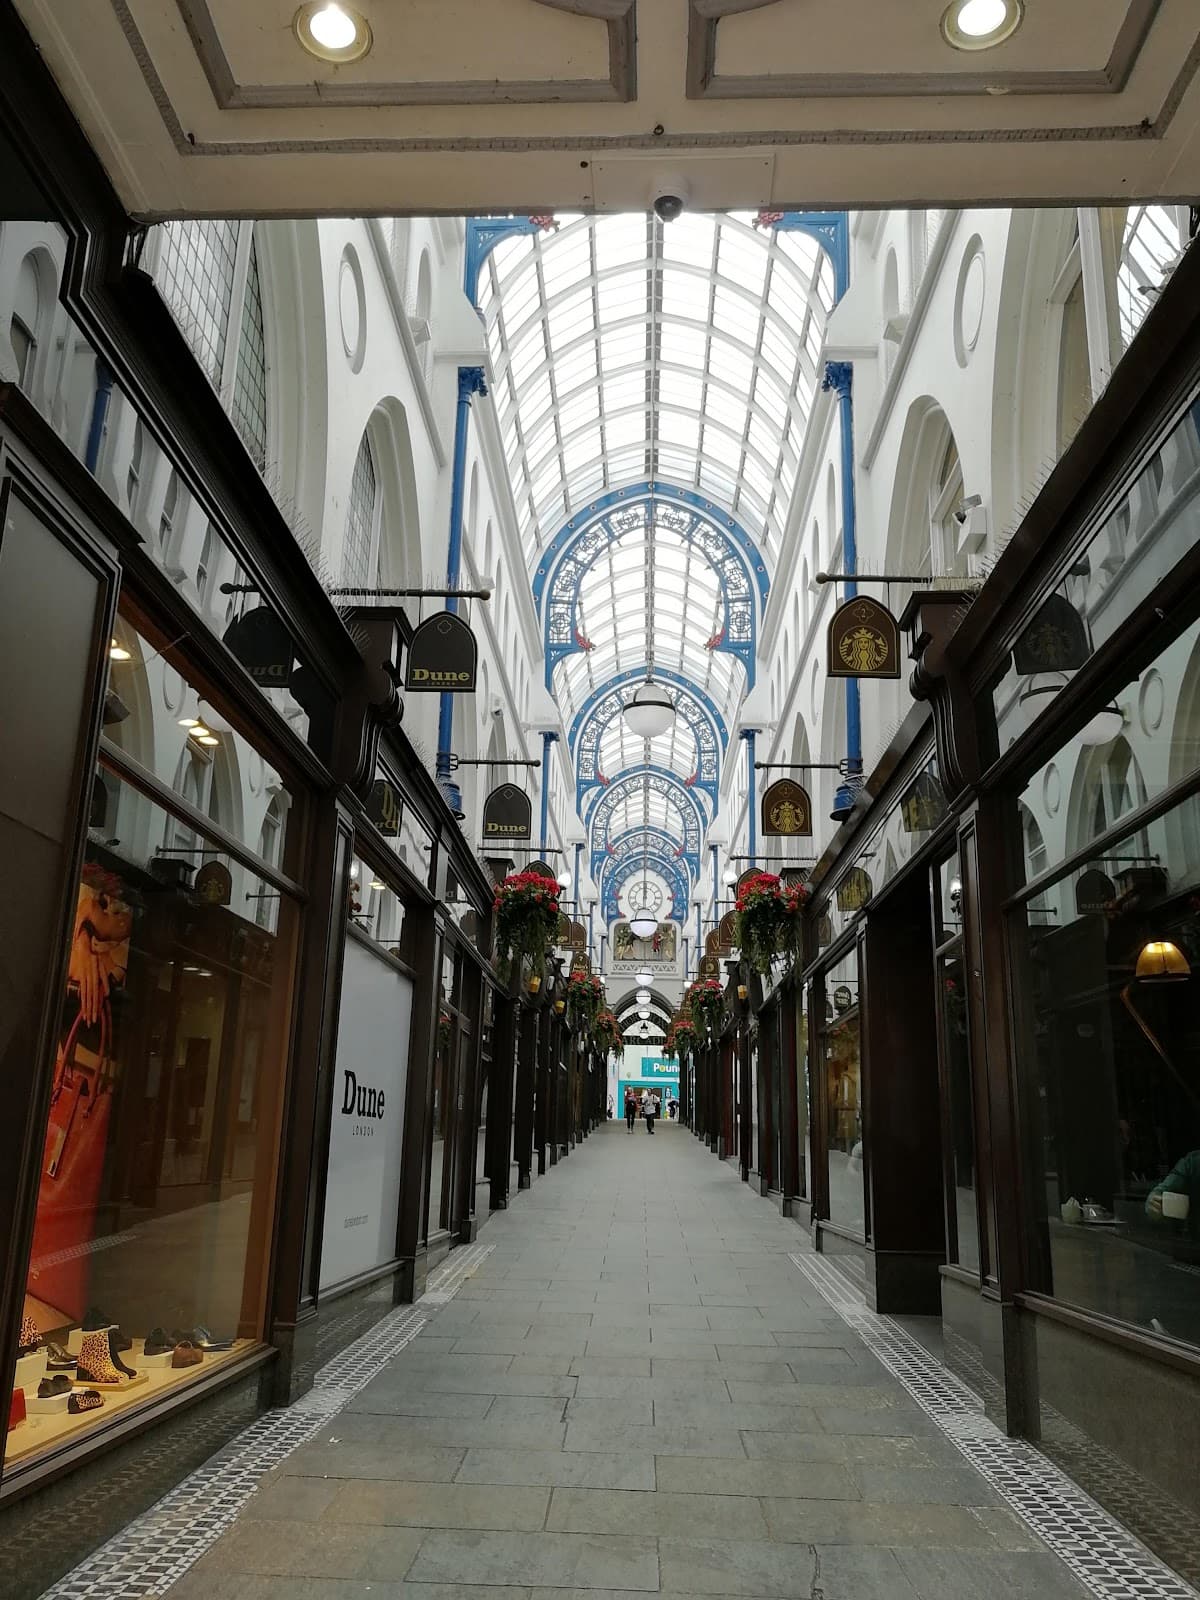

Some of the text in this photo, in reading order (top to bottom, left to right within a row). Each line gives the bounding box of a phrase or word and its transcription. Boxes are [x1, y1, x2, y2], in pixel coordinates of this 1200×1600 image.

[412, 668, 470, 681] Dune
[487, 822, 527, 833] Dune
[653, 1063, 680, 1073] Poun
[341, 1069, 386, 1120] Dune
[352, 1125, 375, 1137] LONDON
